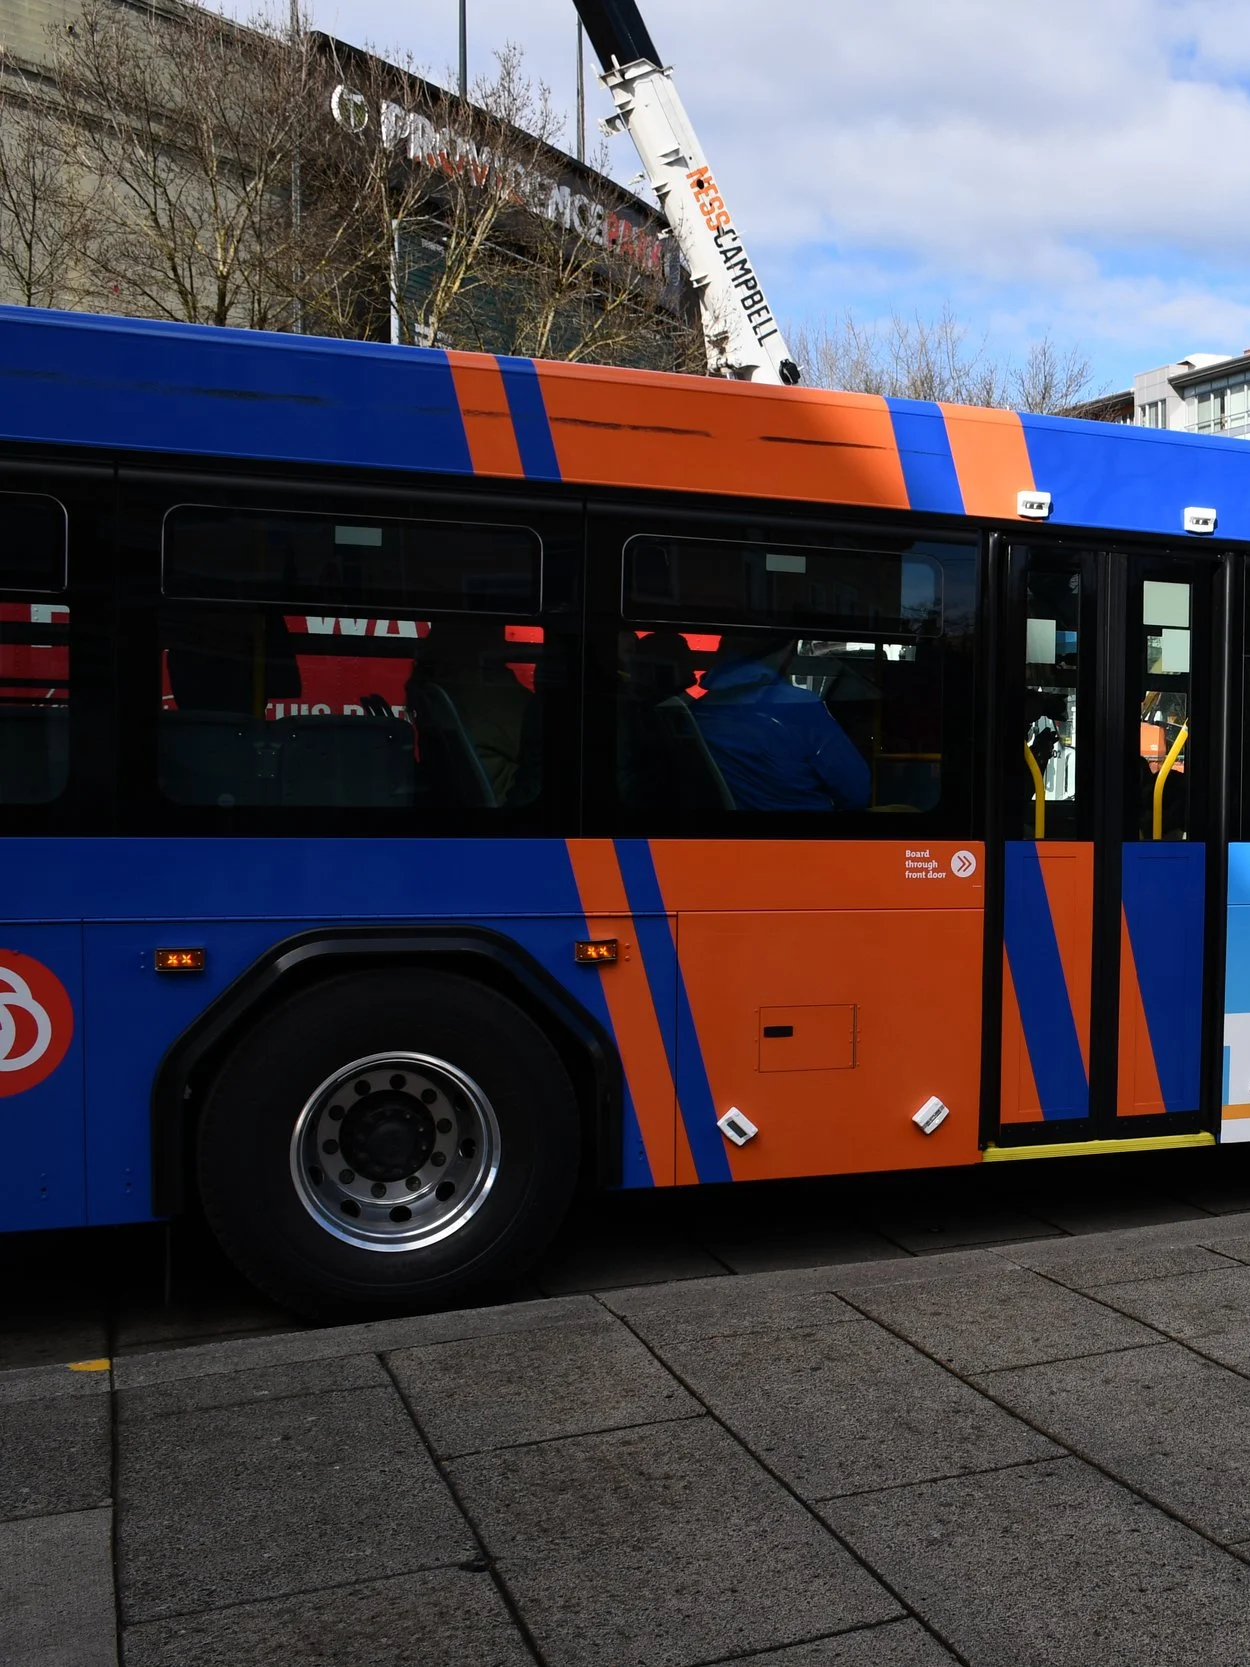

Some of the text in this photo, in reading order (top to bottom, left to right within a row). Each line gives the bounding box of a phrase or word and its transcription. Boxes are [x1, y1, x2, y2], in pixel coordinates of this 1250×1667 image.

[905, 850, 930, 858] Board
[905, 860, 938, 871] through
[905, 871, 946, 879] front door
